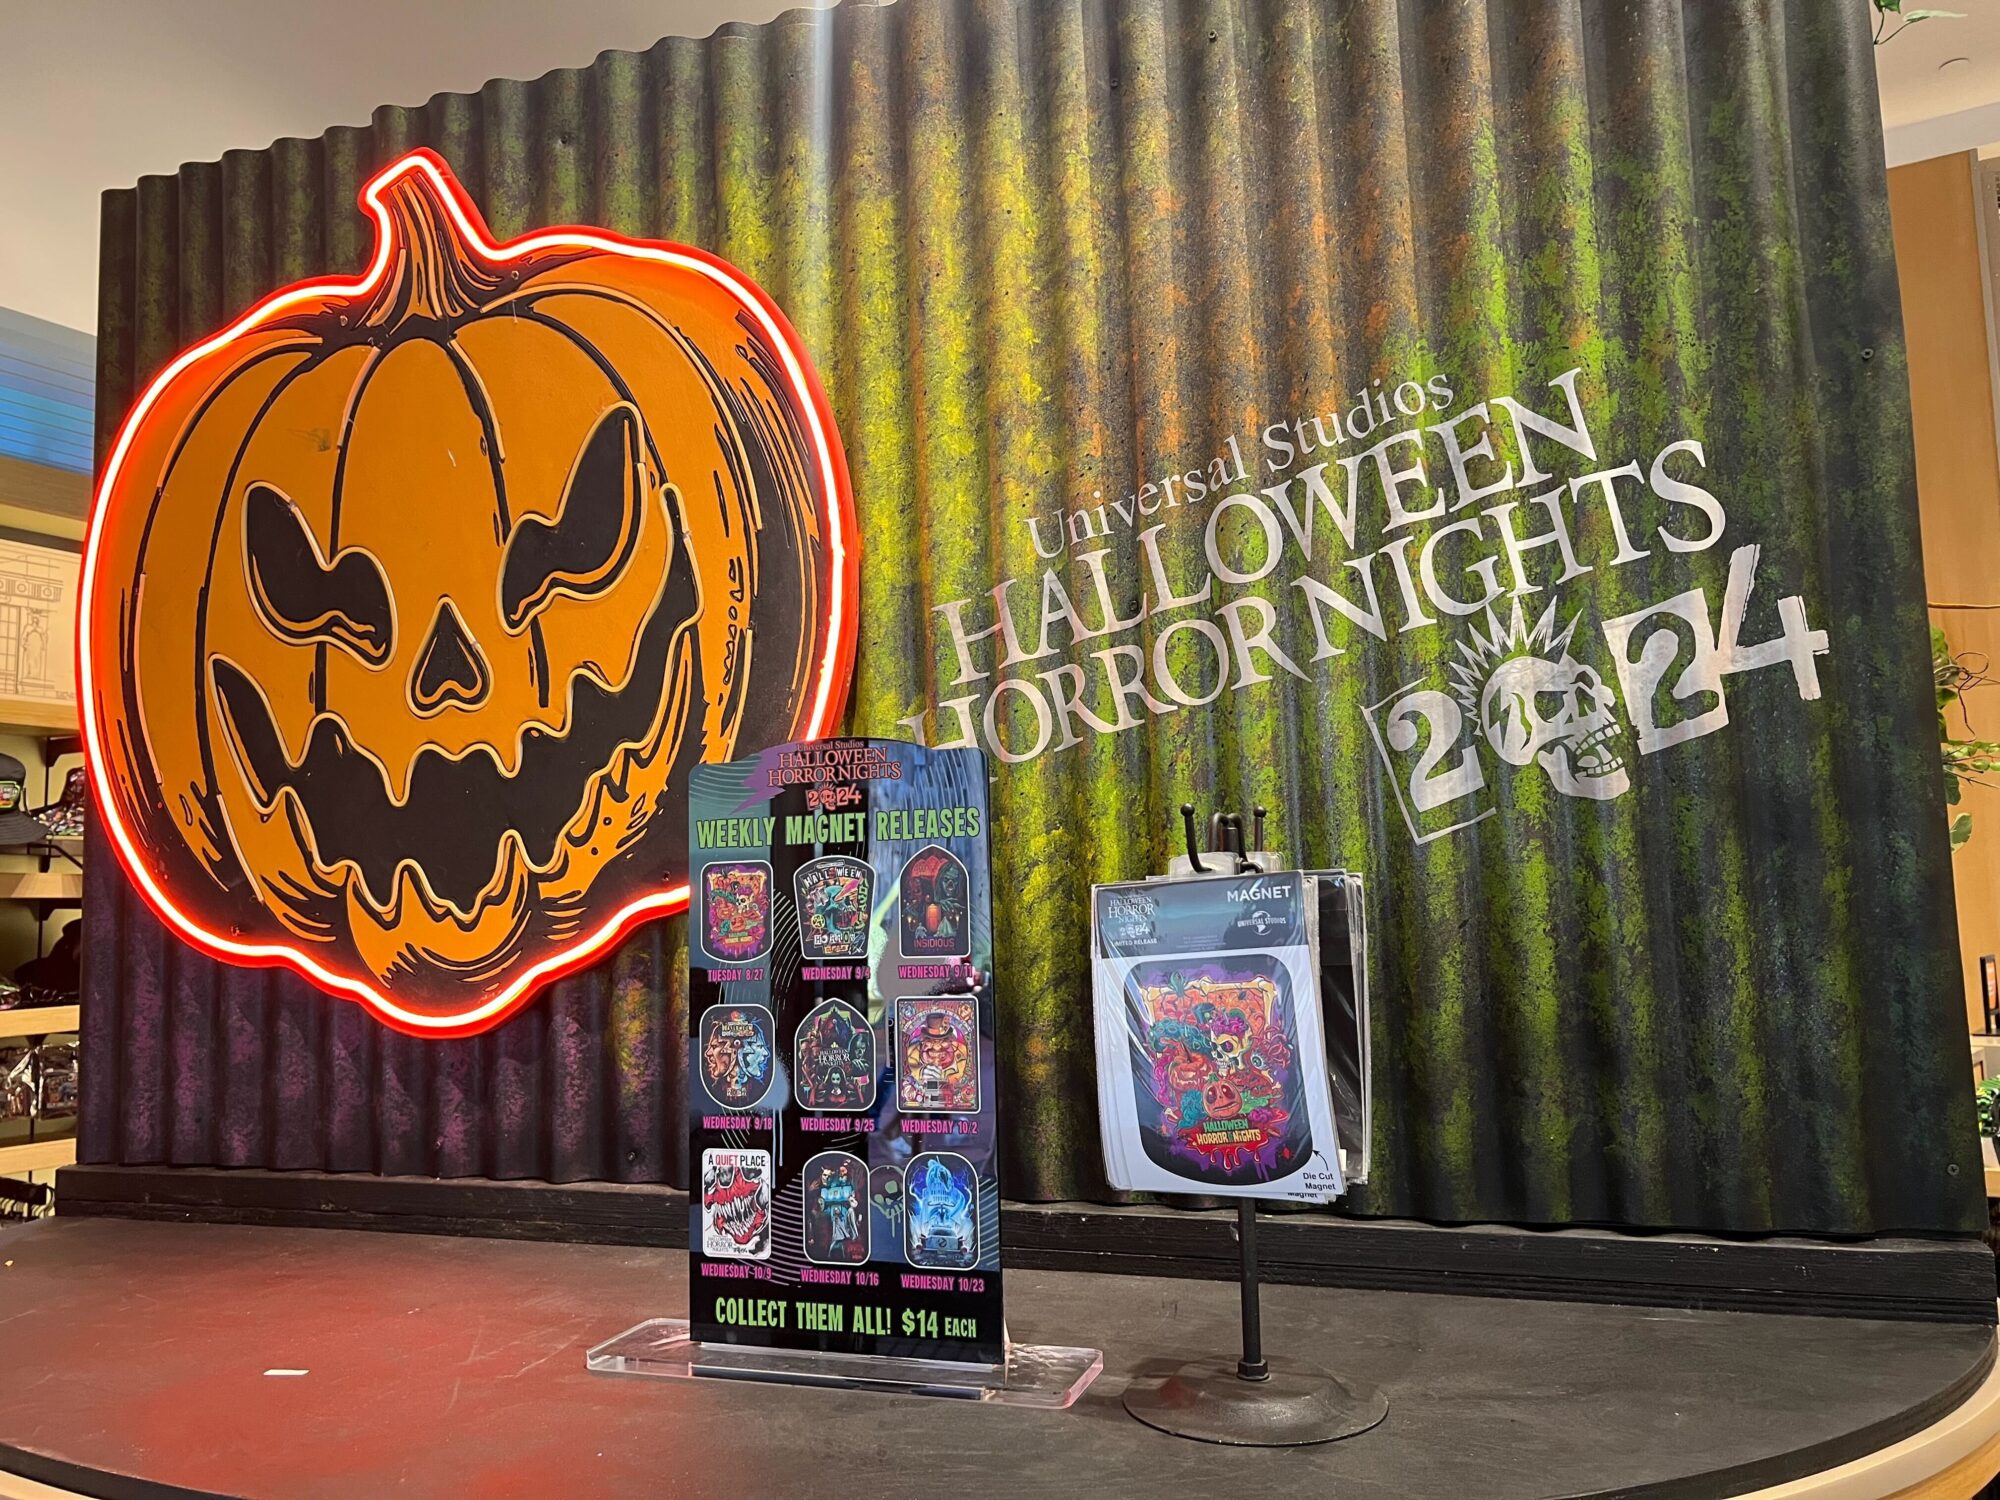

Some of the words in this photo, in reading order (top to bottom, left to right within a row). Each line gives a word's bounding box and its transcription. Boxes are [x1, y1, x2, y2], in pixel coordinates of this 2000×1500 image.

[1024, 435, 1252, 560] Universal
[1262, 373, 1454, 473] Studios
[931, 367, 1598, 686] HALLOWEEN
[1290, 438, 1726, 662] NIGHTS
[797, 742, 833, 752] Universal
[834, 740, 865, 749] Studios
[779, 747, 887, 769] HALLOWEEN
[768, 766, 838, 787] HORROR
[837, 762, 902, 781] NIGHTS
[696, 816, 776, 848] WEEKLY
[785, 812, 866, 845] MAGNET
[876, 807, 980, 841] RELEASES
[1227, 885, 1291, 903] MAGNET
[1108, 903, 1156, 919] HORROR
[1237, 918, 1264, 928] UNIVERSAL
[1265, 917, 1287, 925] STUDIOS
[914, 938, 955, 948] INSIDIOUS
[708, 969, 743, 982] TUESDAY
[745, 968, 764, 981] 8/27
[802, 967, 852, 981] WEDNESDAY
[855, 966, 871, 980] 9/4
[898, 965, 951, 979] WEDNESDAY
[954, 964, 973, 978] 9/11
[703, 1116, 752, 1130] WEDNESDAY
[754, 1116, 772, 1131] 9/18
[800, 1117, 852, 1131] WEDNESDAY
[855, 1118, 875, 1132] 9/25
[901, 1119, 954, 1134] WEDNESDAY
[957, 1120, 978, 1135] 10/2
[1203, 1119, 1249, 1133] HALLOWEEN
[1196, 1131, 1228, 1145] HORROR
[708, 1154, 714, 1165] A
[715, 1154, 739, 1166] QUIET
[740, 1155, 766, 1167] PLACE
[1303, 1172, 1317, 1180] Die
[1318, 1172, 1334, 1180] Cut
[1305, 1182, 1336, 1191] Magnet
[701, 1263, 750, 1278] WEDNESDAY
[753, 1266, 772, 1280] 10/9
[800, 1268, 852, 1284] WEDNESDAY
[855, 1271, 880, 1286] 10/16
[901, 1274, 955, 1290] WEDNESDAY
[957, 1276, 985, 1292] 10/23
[715, 1297, 787, 1328] COLLECT
[795, 1301, 843, 1332] THEM
[852, 1306, 892, 1334] ALL!
[901, 1308, 938, 1338] $14
[944, 1317, 977, 1338] EACH
